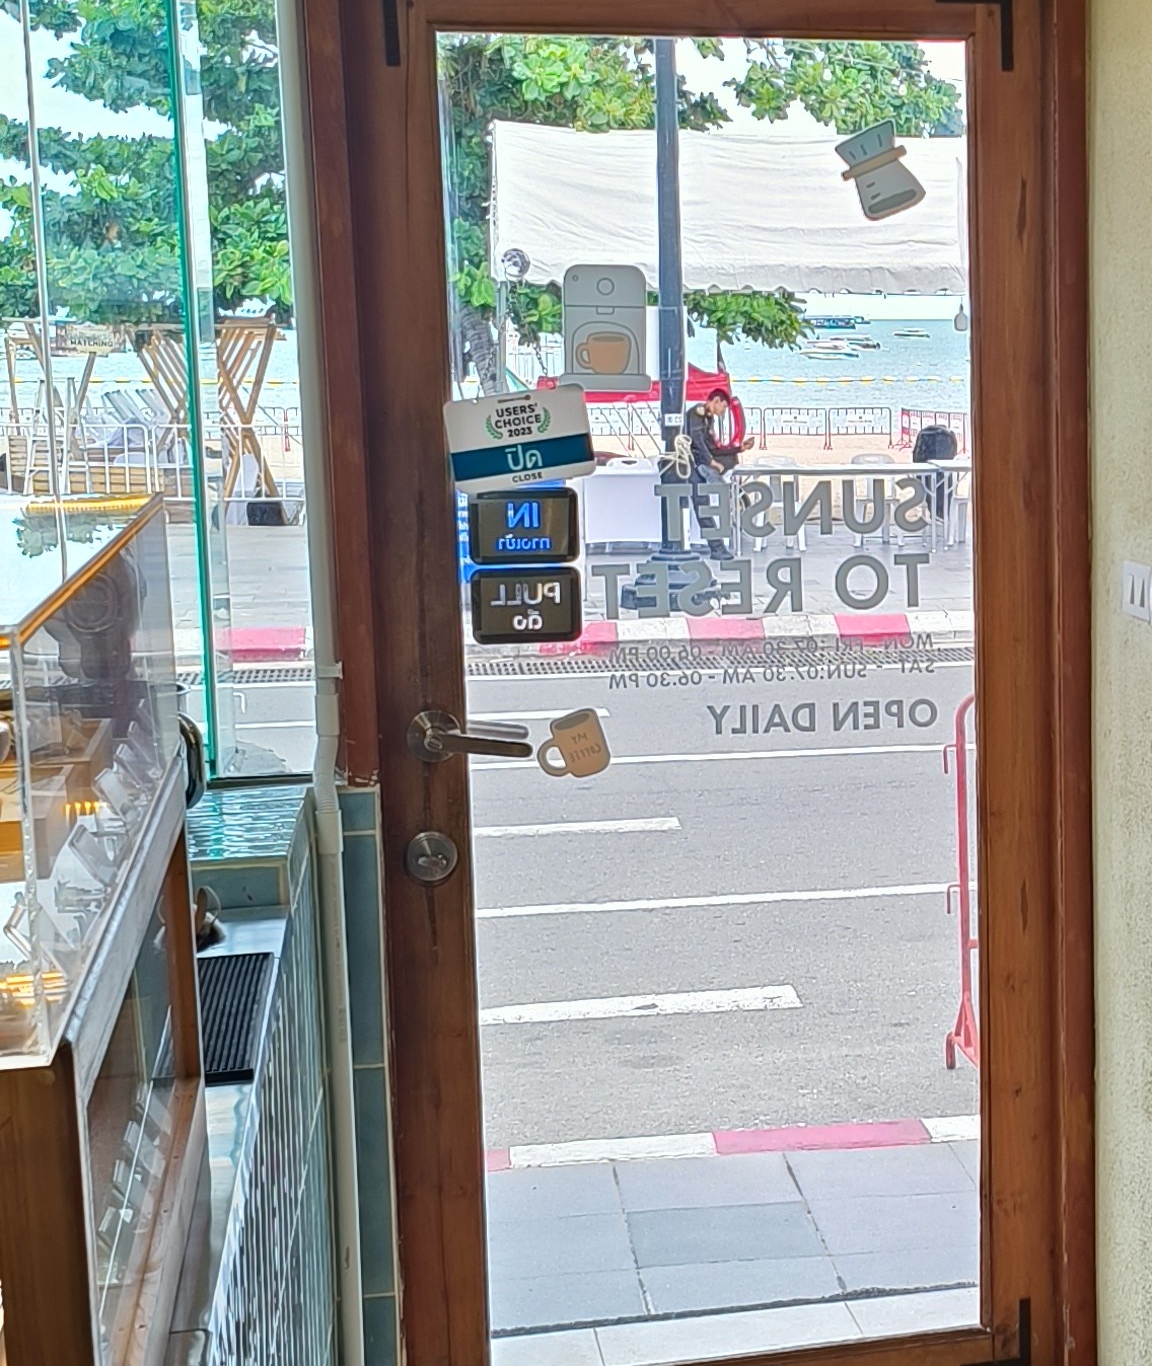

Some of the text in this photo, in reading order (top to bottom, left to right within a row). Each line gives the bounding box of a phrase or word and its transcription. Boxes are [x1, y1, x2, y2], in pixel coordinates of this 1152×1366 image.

[496, 403, 538, 418] USERS'
[495, 414, 541, 429] CHOICE
[508, 426, 533, 438] 2023
[505, 444, 543, 471] ปิด
[512, 472, 543, 483] CLOSE
